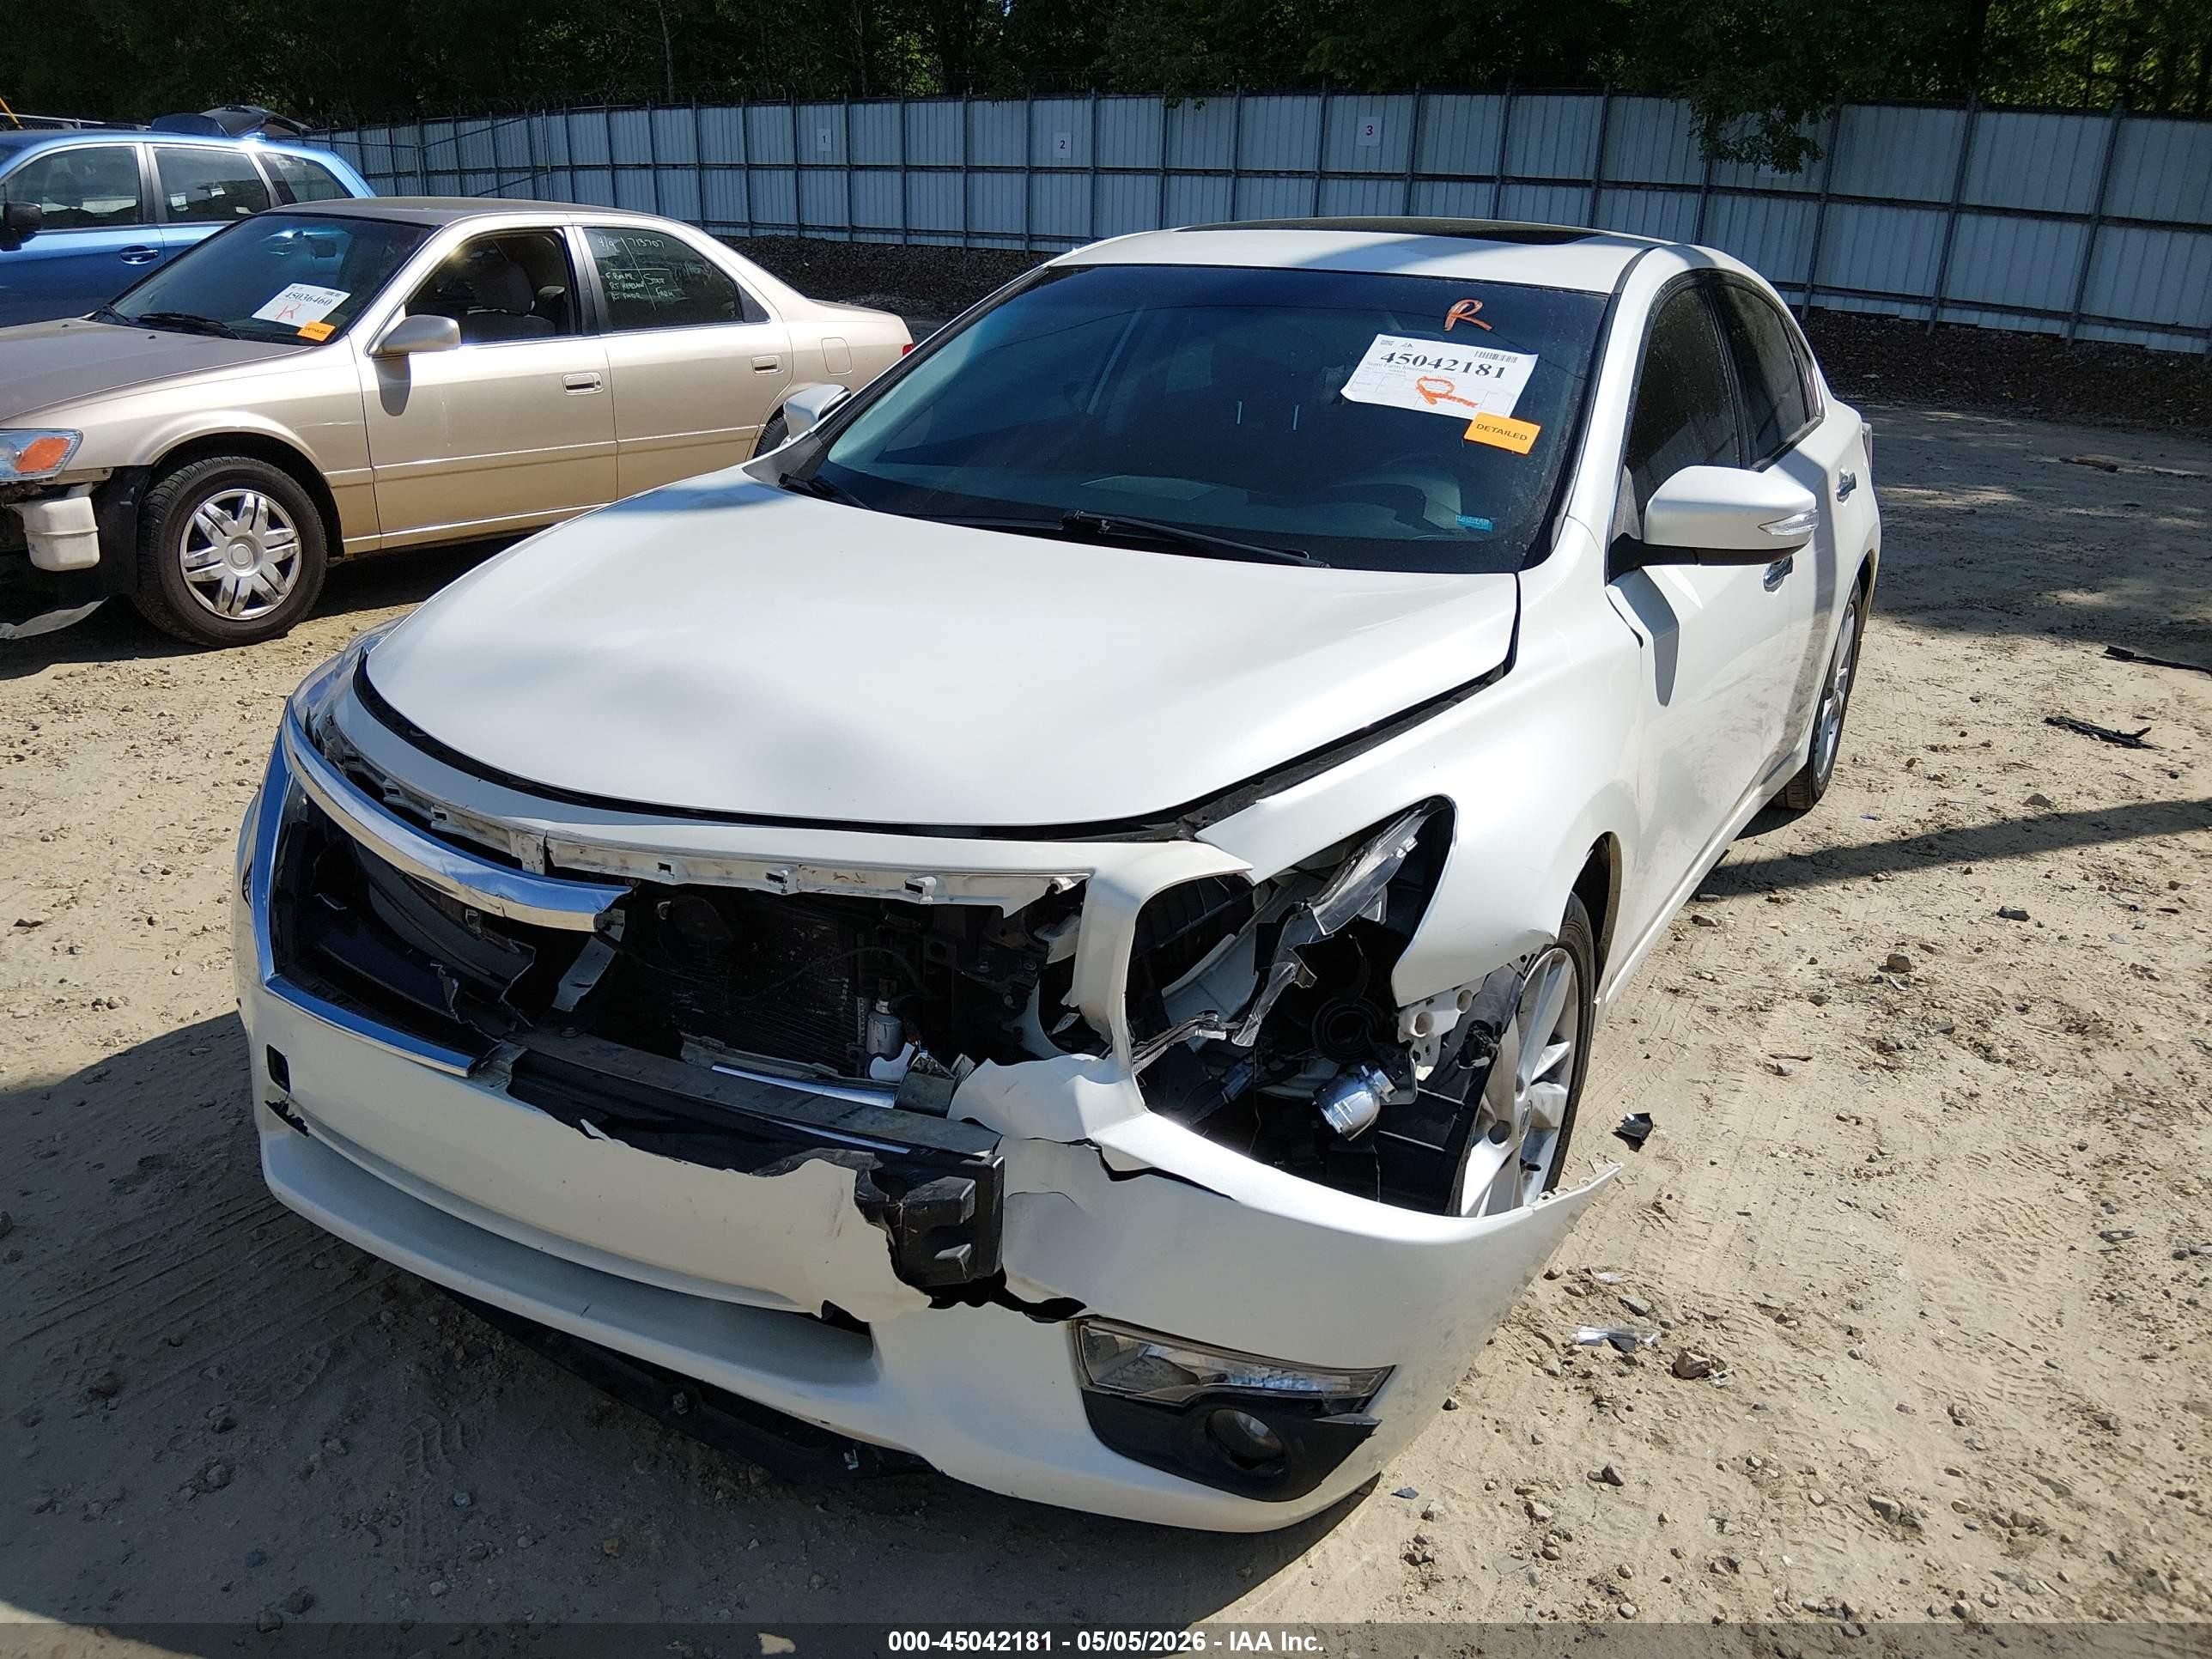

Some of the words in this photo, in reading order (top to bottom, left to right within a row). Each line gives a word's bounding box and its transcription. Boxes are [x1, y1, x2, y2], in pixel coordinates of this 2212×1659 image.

[1366, 125, 1373, 136] 3
[1060, 140, 1066, 149] 2
[1443, 298, 1493, 331] R
[1381, 351, 1505, 380] 45042181
[1476, 423, 1528, 441] DETAILED
